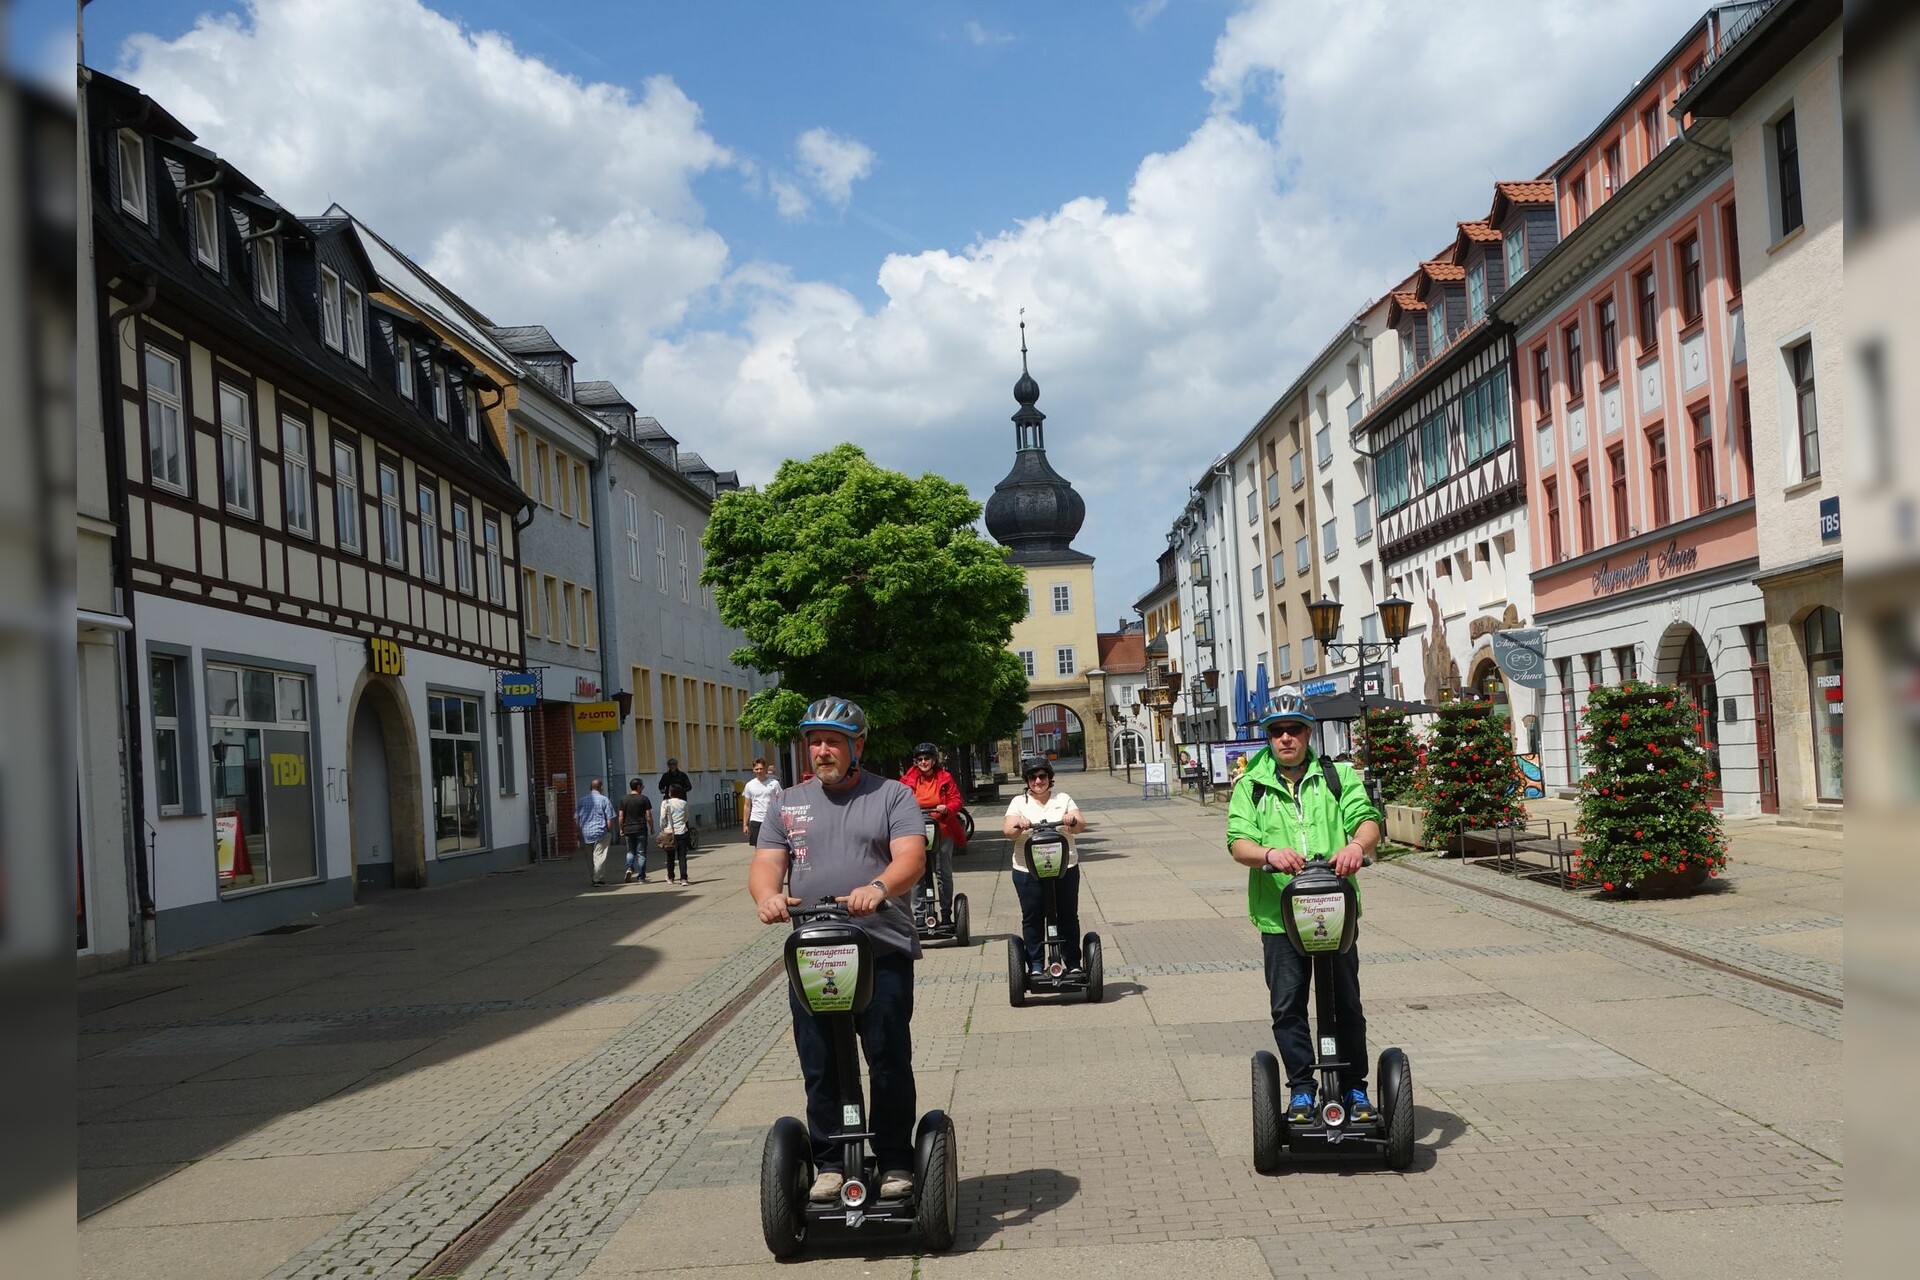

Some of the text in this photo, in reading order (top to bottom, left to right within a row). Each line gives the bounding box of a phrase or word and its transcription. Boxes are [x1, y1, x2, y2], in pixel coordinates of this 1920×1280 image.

[1821, 513, 1839, 533] TBS
[1592, 551, 1649, 593] Augenoptik
[1495, 637, 1540, 649] Augenoptik
[371, 637, 406, 676] TEDi
[1817, 674, 1841, 688] FRISEUR
[503, 684, 535, 695] TEDi
[589, 711, 615, 719] LOTTO
[270, 753, 306, 786] TEDi
[1294, 896, 1342, 906] Ferienagentur
[1303, 906, 1335, 916] Hofmann
[799, 947, 856, 959] Ferienagentur
[809, 959, 847, 971] Hofmann
